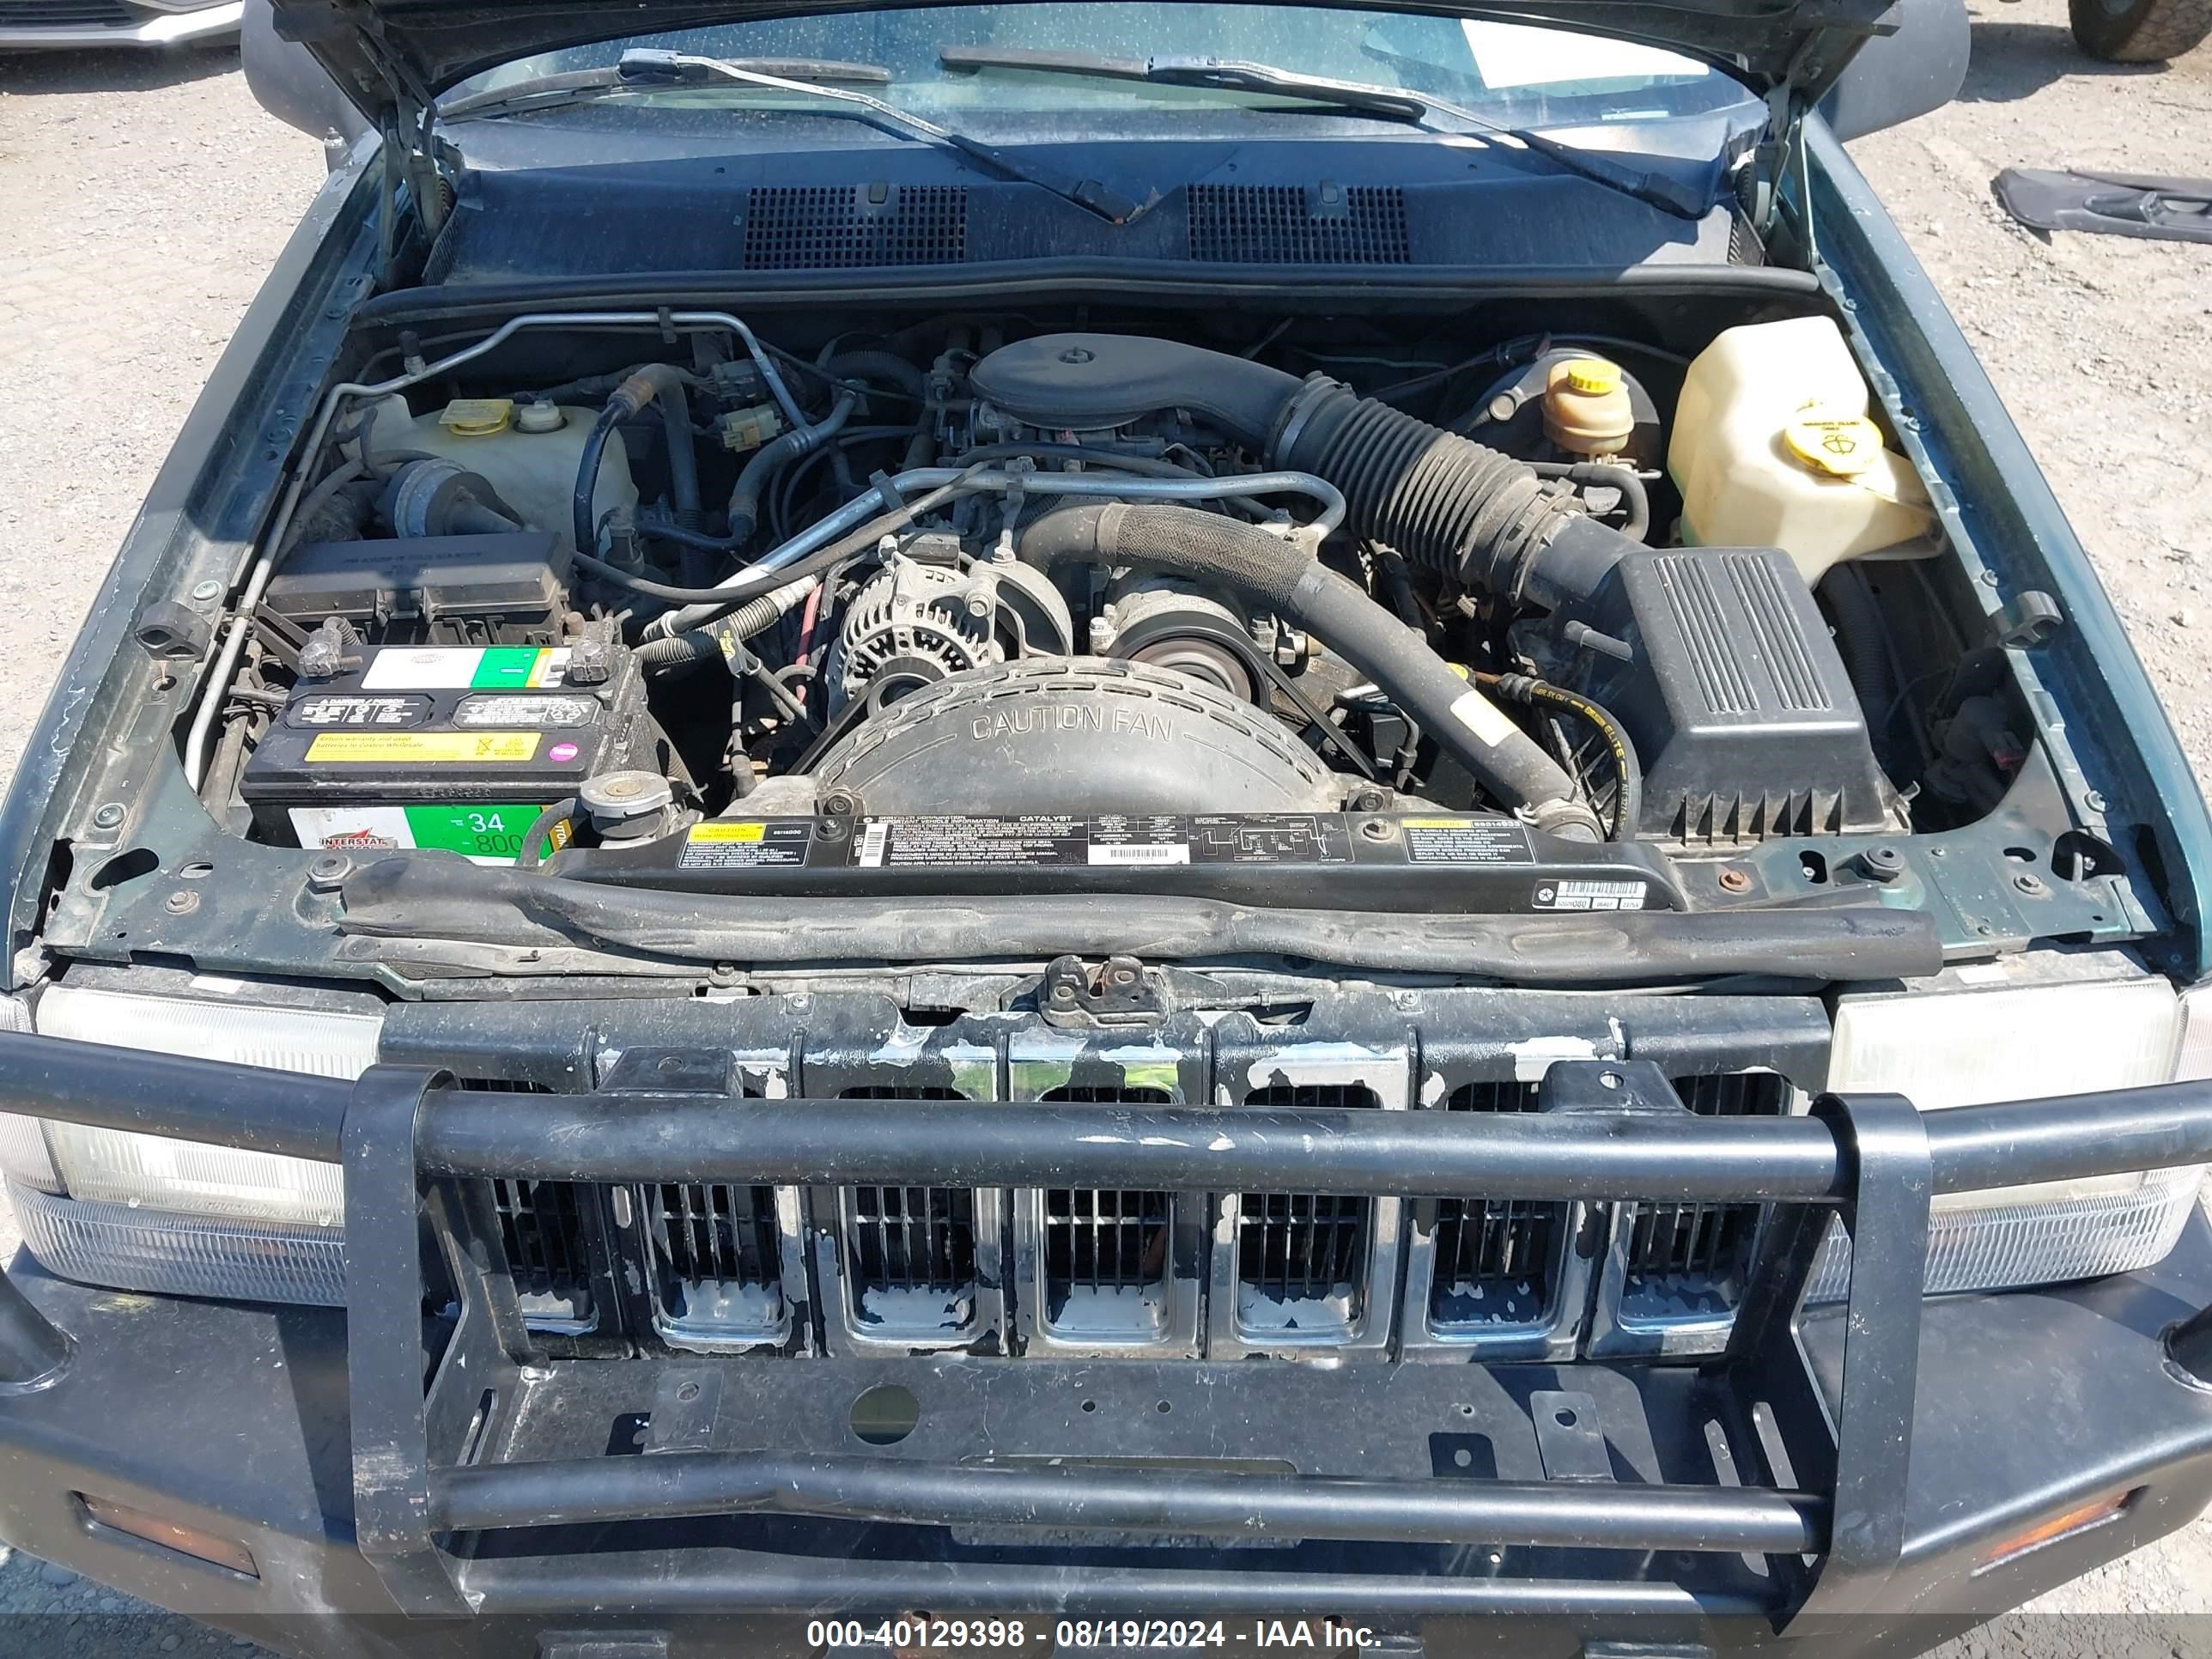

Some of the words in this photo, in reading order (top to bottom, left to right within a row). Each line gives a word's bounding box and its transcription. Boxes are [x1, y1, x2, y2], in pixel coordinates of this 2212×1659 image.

[970, 706, 1102, 741] CAUTION
[1113, 708, 1172, 742] FAN
[1604, 725, 1625, 760] ELITE
[469, 812, 505, 833] 34
[476, 834, 523, 854] 800
